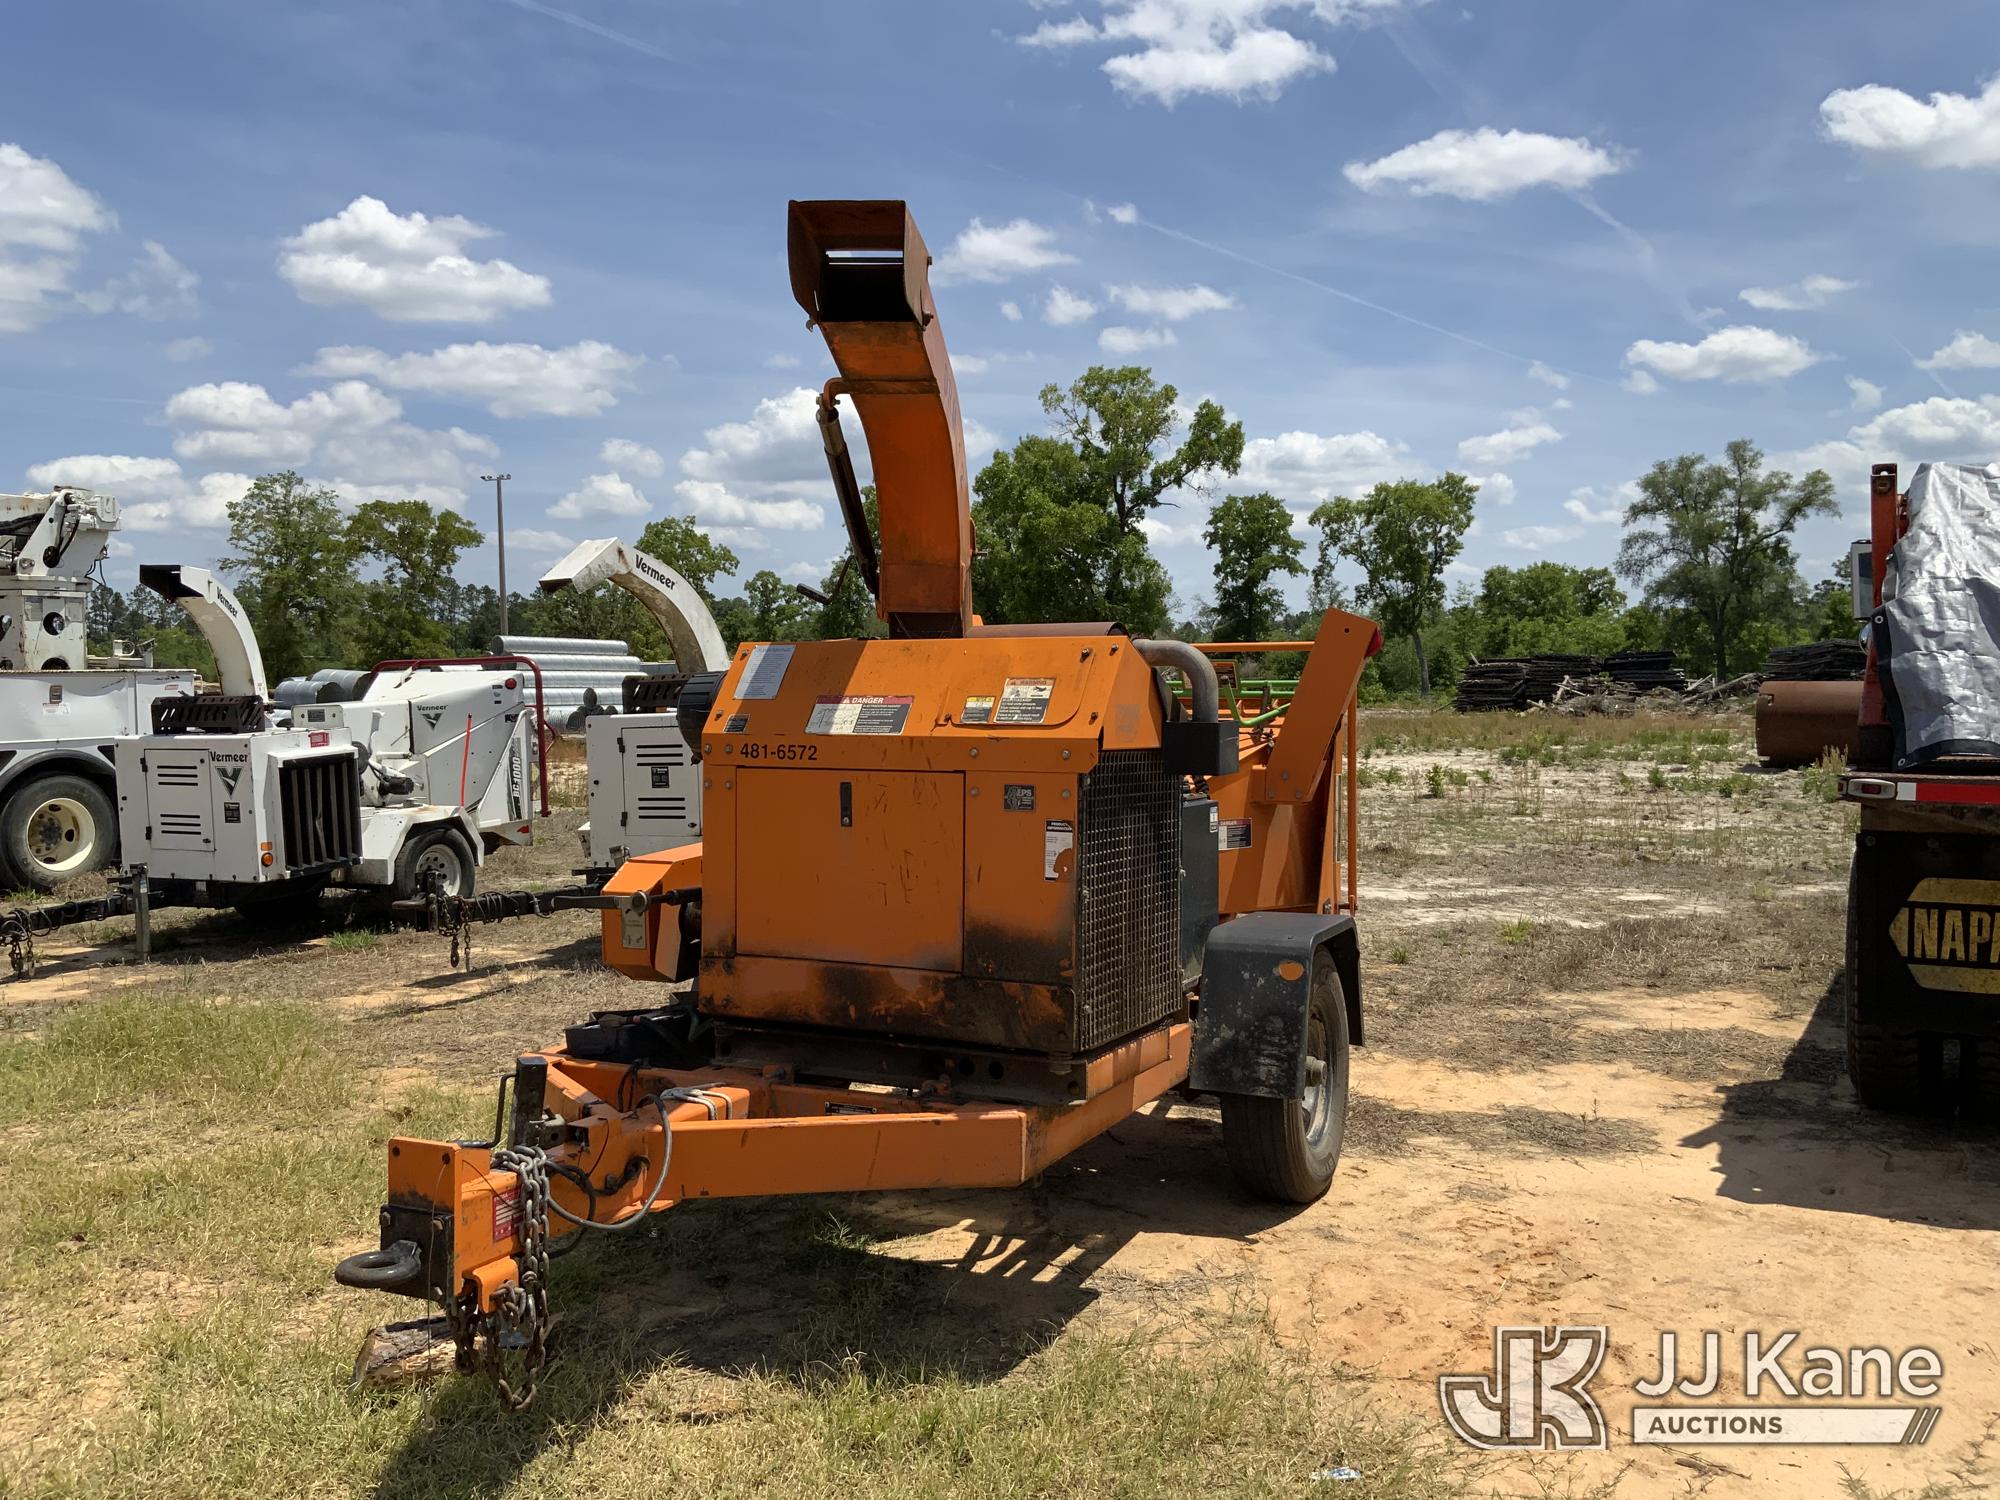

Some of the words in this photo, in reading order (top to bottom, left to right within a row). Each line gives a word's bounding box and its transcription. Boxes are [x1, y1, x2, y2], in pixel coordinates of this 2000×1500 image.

[636, 554, 675, 590] Vermeer
[210, 751, 248, 763] Vermeer
[740, 743, 818, 761] 481-6572
